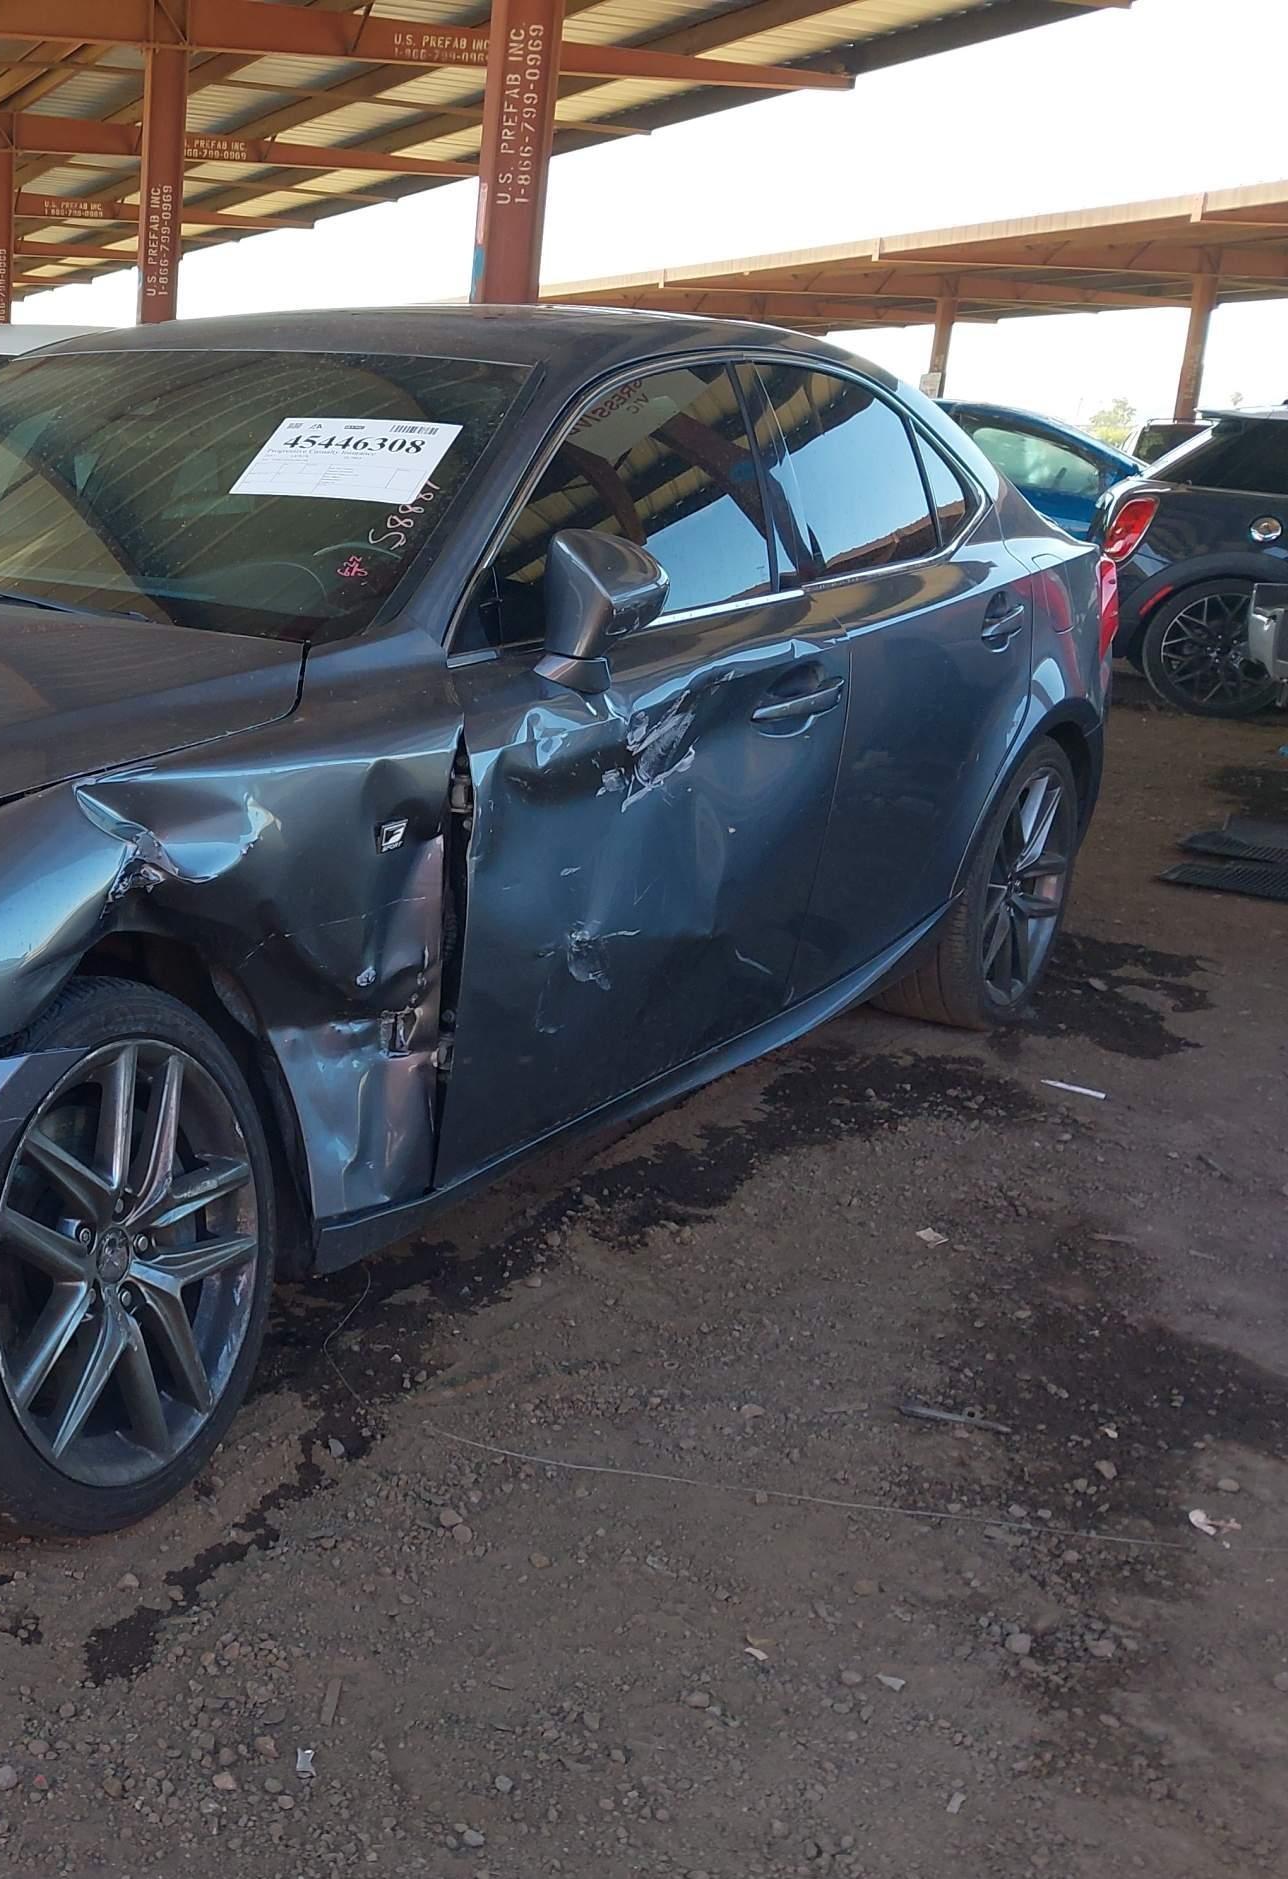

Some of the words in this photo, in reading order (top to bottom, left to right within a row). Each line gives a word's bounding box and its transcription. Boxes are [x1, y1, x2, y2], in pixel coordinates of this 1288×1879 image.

[394, 33, 416, 46] U.S.
[422, 35, 467, 49] PREFAB
[501, 73, 522, 153] PREFAB
[515, 24, 545, 204] 1-866-799-0969
[194, 139, 228, 150] PREFAB
[496, 167, 514, 205] U.S.
[147, 214, 160, 265] PREFAB
[146, 271, 158, 297] U.S.
[283, 434, 426, 454] 45446308
